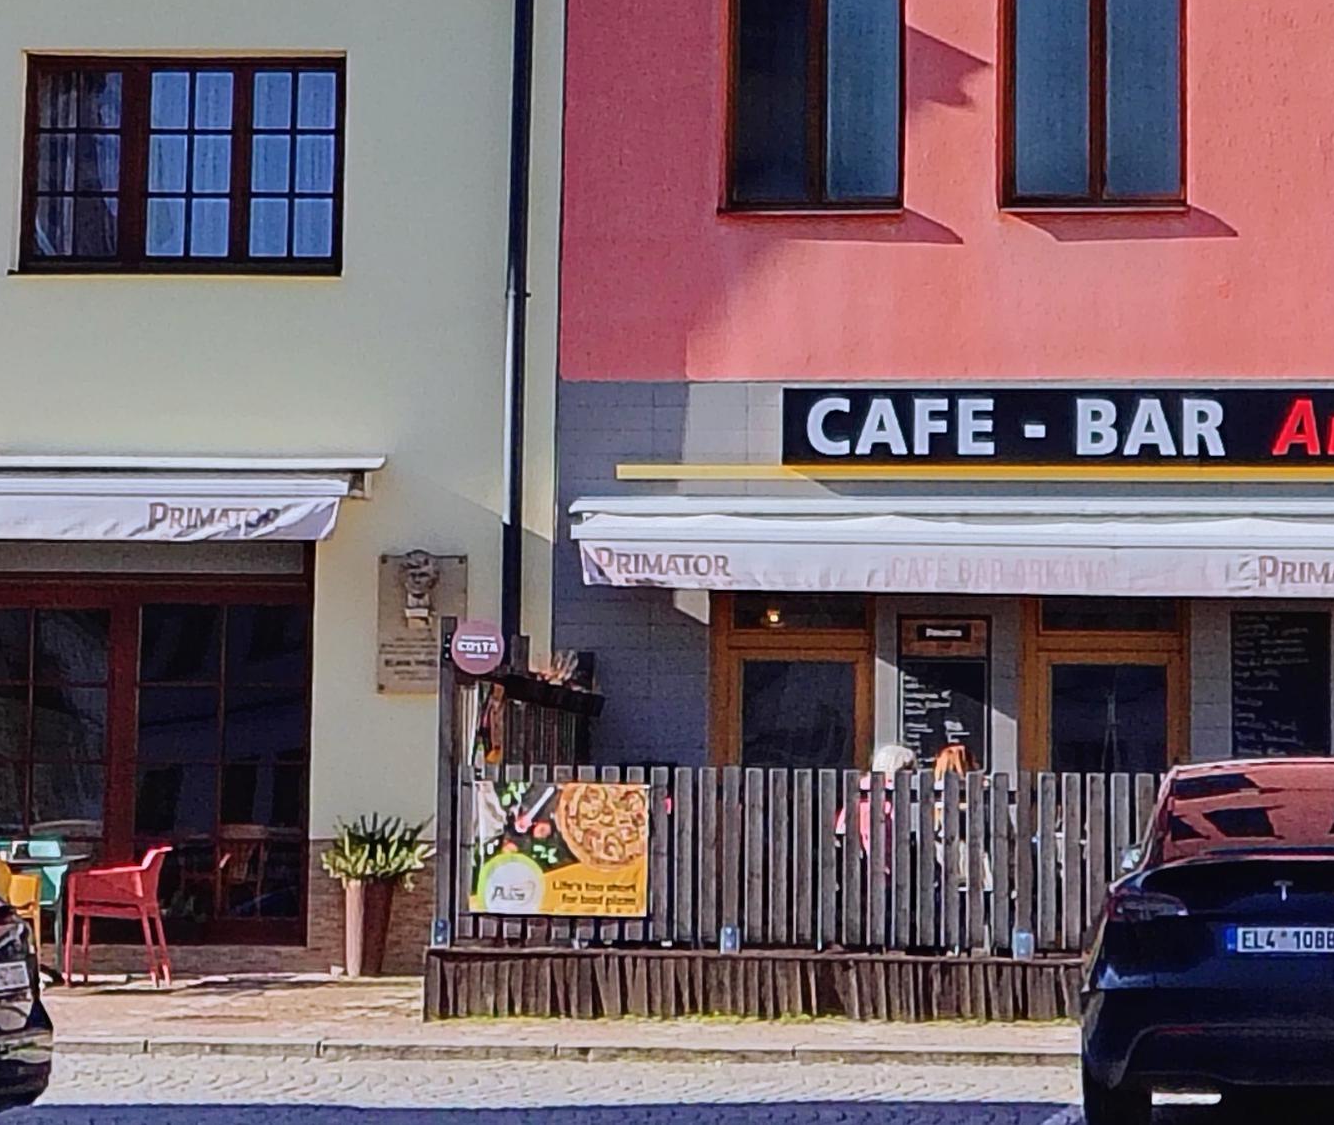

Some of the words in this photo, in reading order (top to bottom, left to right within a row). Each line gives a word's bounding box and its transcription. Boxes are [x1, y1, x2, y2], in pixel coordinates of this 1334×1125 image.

[806, 397, 996, 457] CAFE
[1076, 397, 1226, 457] BAR
[148, 502, 283, 530] PRIMATOR
[594, 547, 732, 576] PRIMATOR
